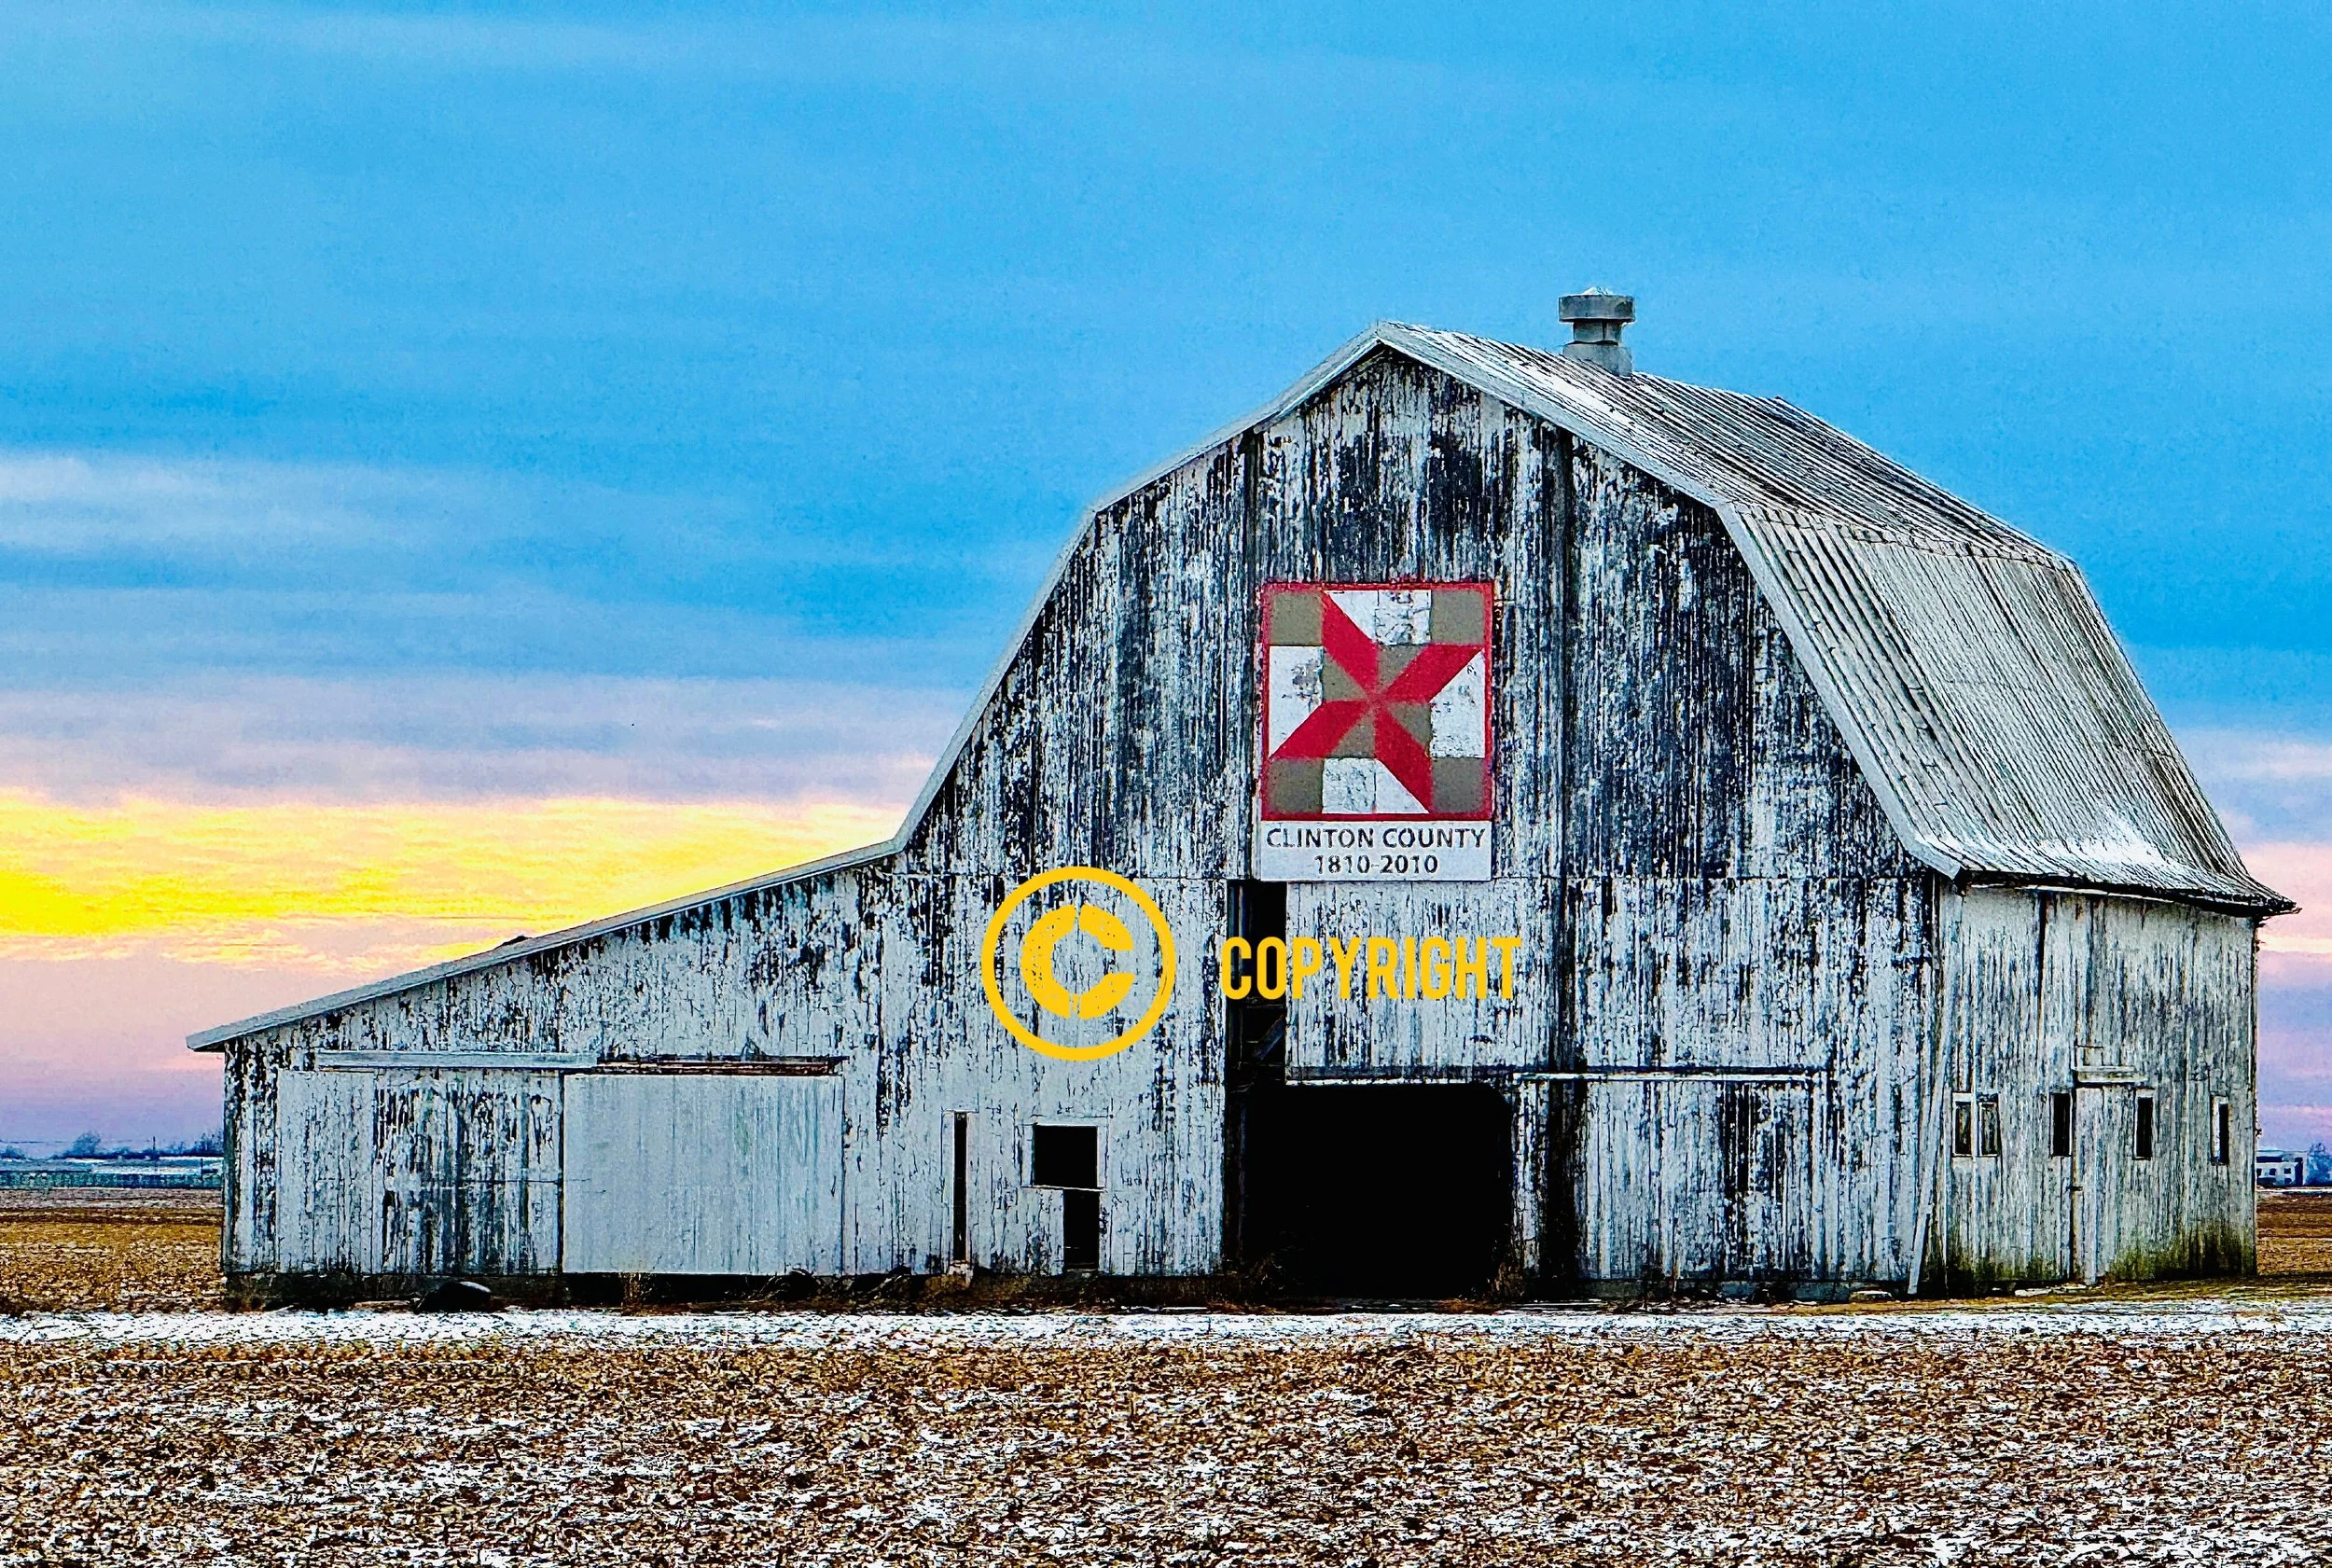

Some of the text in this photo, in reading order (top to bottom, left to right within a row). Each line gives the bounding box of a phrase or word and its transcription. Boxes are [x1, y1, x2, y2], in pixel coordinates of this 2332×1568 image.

[1266, 827, 1486, 848] CLINTON COUNTY
[1314, 854, 1438, 874] 1810-2010
